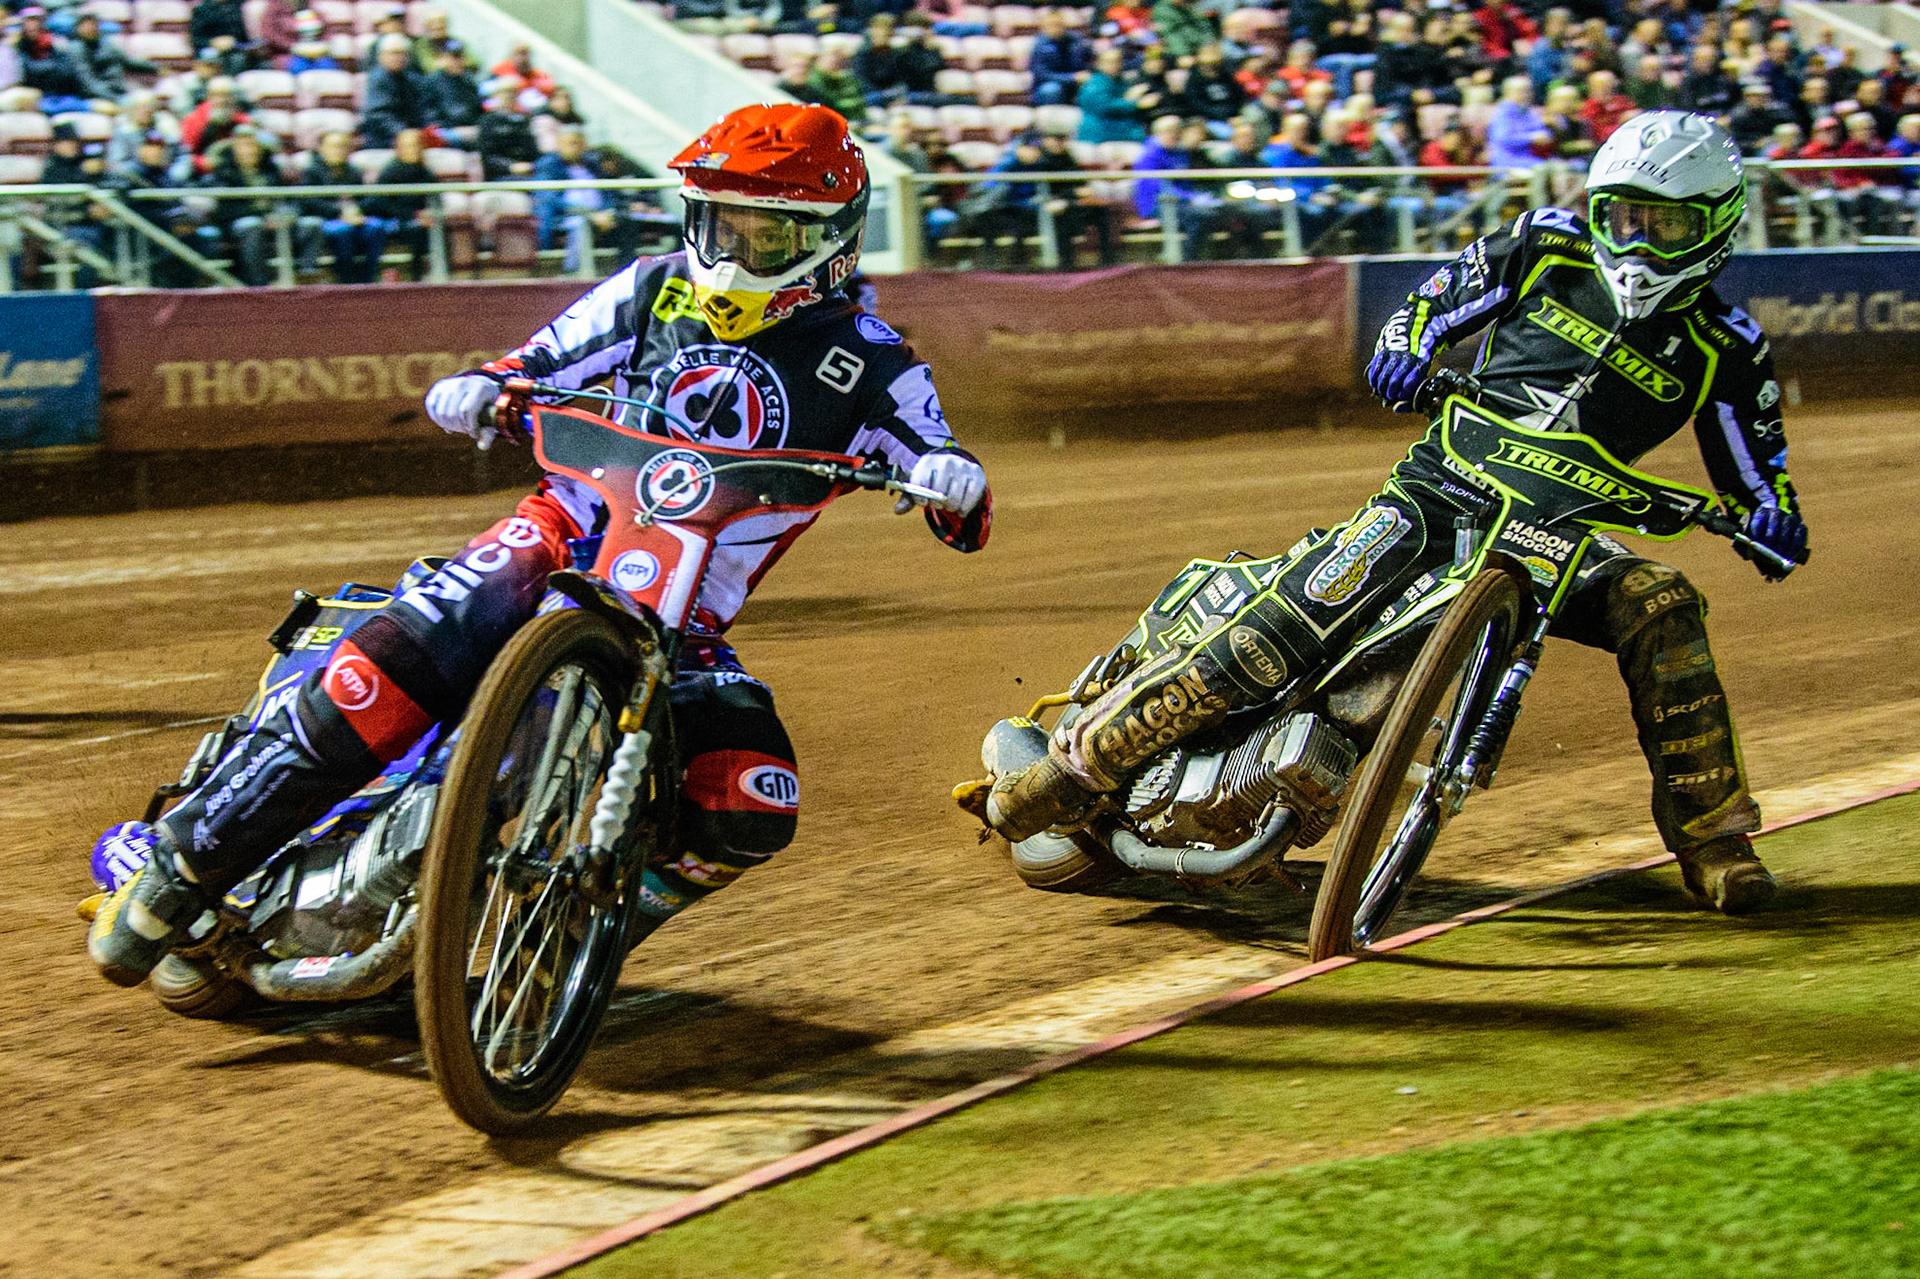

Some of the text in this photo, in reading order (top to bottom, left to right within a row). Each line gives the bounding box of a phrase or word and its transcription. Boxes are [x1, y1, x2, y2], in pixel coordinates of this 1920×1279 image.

[1663, 335, 1682, 356] 1
[667, 351, 781, 430] BELLE VUE ACES
[1608, 347, 1674, 395] MIX
[1505, 444, 1640, 501] TRU MIX
[1316, 515, 1393, 592] AGROMIX
[1500, 530, 1568, 562] SHOCKS
[1505, 519, 1576, 554] HAGON
[1159, 570, 1208, 612] 1
[1233, 632, 1283, 686] ORTEMA
[1666, 693, 1723, 718] SCOTT
